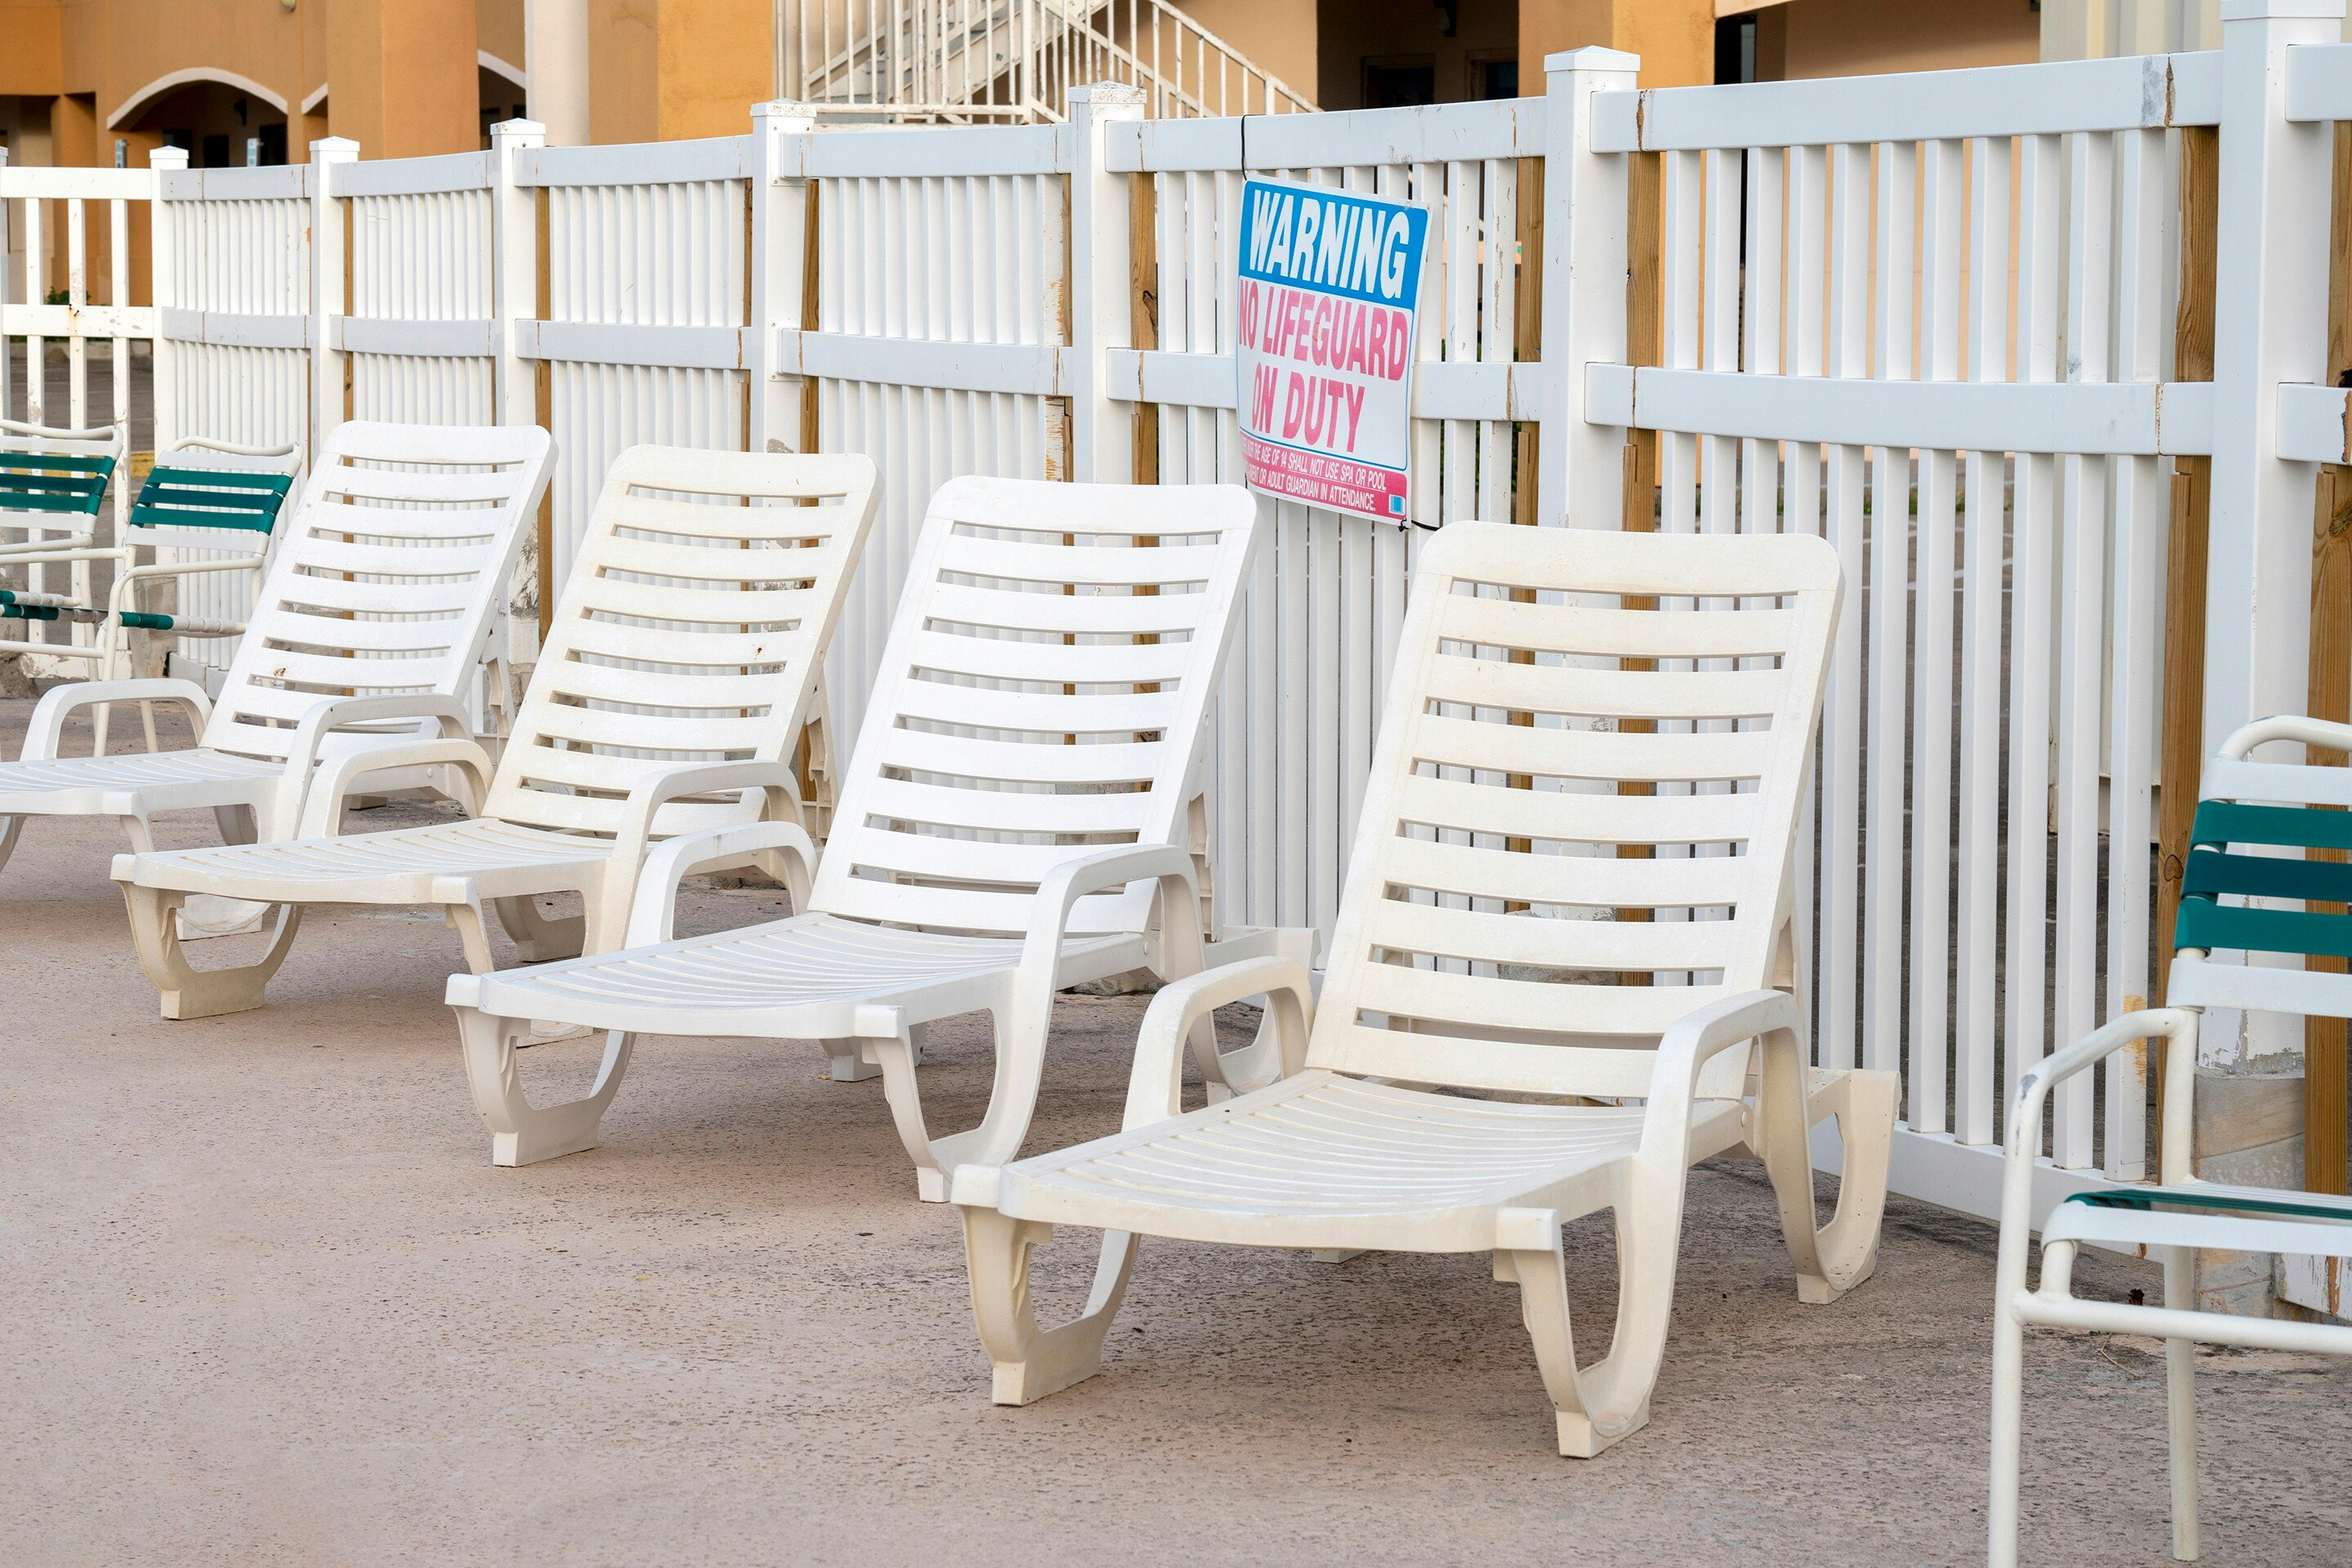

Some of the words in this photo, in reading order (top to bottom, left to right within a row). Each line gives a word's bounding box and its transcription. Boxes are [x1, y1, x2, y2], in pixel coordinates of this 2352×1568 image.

[1250, 189, 1410, 299] WARNING
[1239, 279, 1258, 350] NO
[1263, 286, 1408, 381] LIFEGUARD
[1252, 362, 1278, 434] ON
[1283, 372, 1365, 452] DUTY
[1259, 468, 1267, 485] OR
[1267, 470, 1285, 490] ADULT
[1286, 474, 1320, 498] GUARDIAN
[1321, 483, 1328, 500] IN
[1329, 485, 1376, 511] ATTENDANCE.
[1260, 446, 1272, 464] AGE
[1272, 448, 1281, 466] OF
[1281, 451, 1287, 468] 14
[1288, 452, 1308, 473] SHALL
[1309, 457, 1325, 476] NOT
[1325, 461, 1340, 480] USE
[1340, 464, 1354, 483] SPA
[1355, 467, 1366, 486] OR
[1367, 470, 1387, 491] POOL
